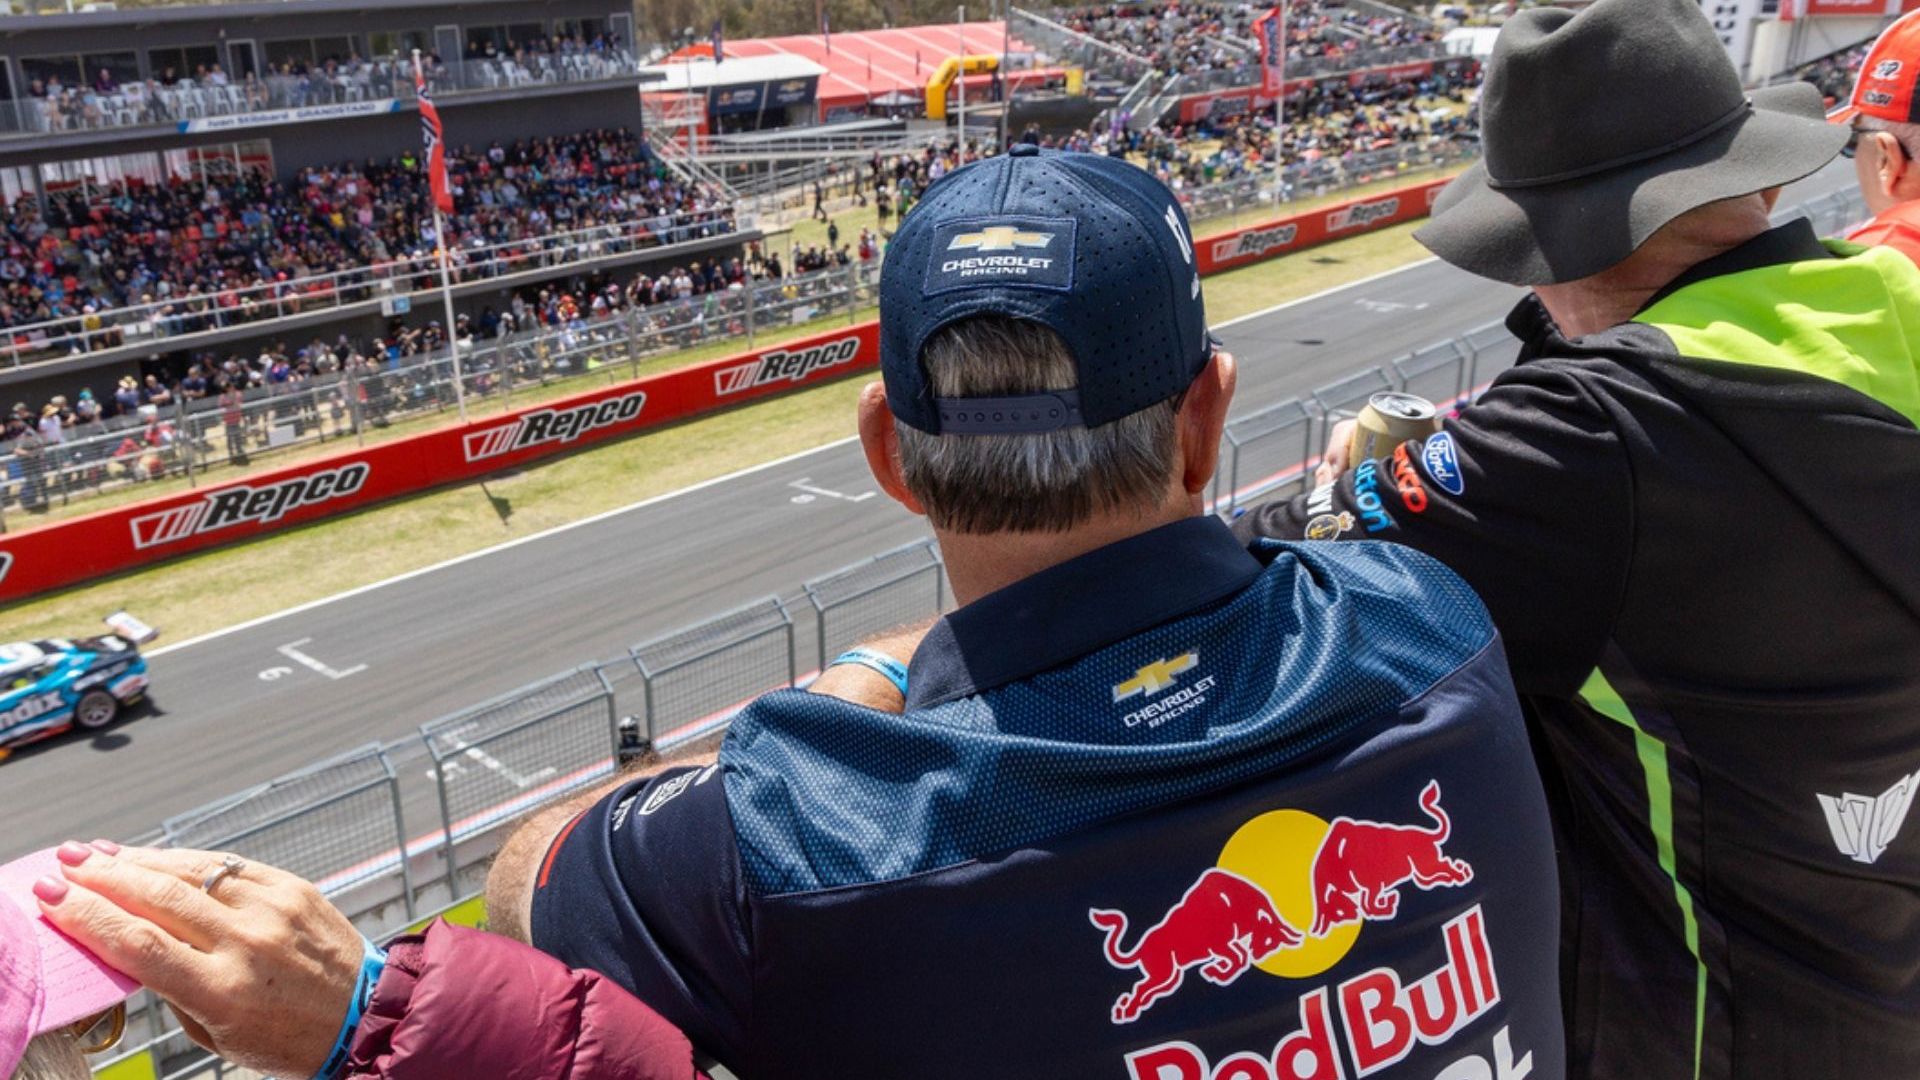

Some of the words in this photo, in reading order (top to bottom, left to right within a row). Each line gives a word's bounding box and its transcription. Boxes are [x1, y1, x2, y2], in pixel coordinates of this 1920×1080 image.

[1349, 198, 1398, 224] Repco
[1237, 225, 1297, 253] Repco
[941, 256, 1053, 273] CHEVROLET
[960, 265, 1028, 277] RACING
[758, 338, 860, 382] Repco
[516, 393, 645, 445] Repco
[1427, 439, 1456, 482] Ford
[202, 463, 369, 529] Repco
[1122, 674, 1216, 728] CHEVROLET
[1148, 695, 1206, 729] RACING
[1339, 905, 1500, 1077] Bull
